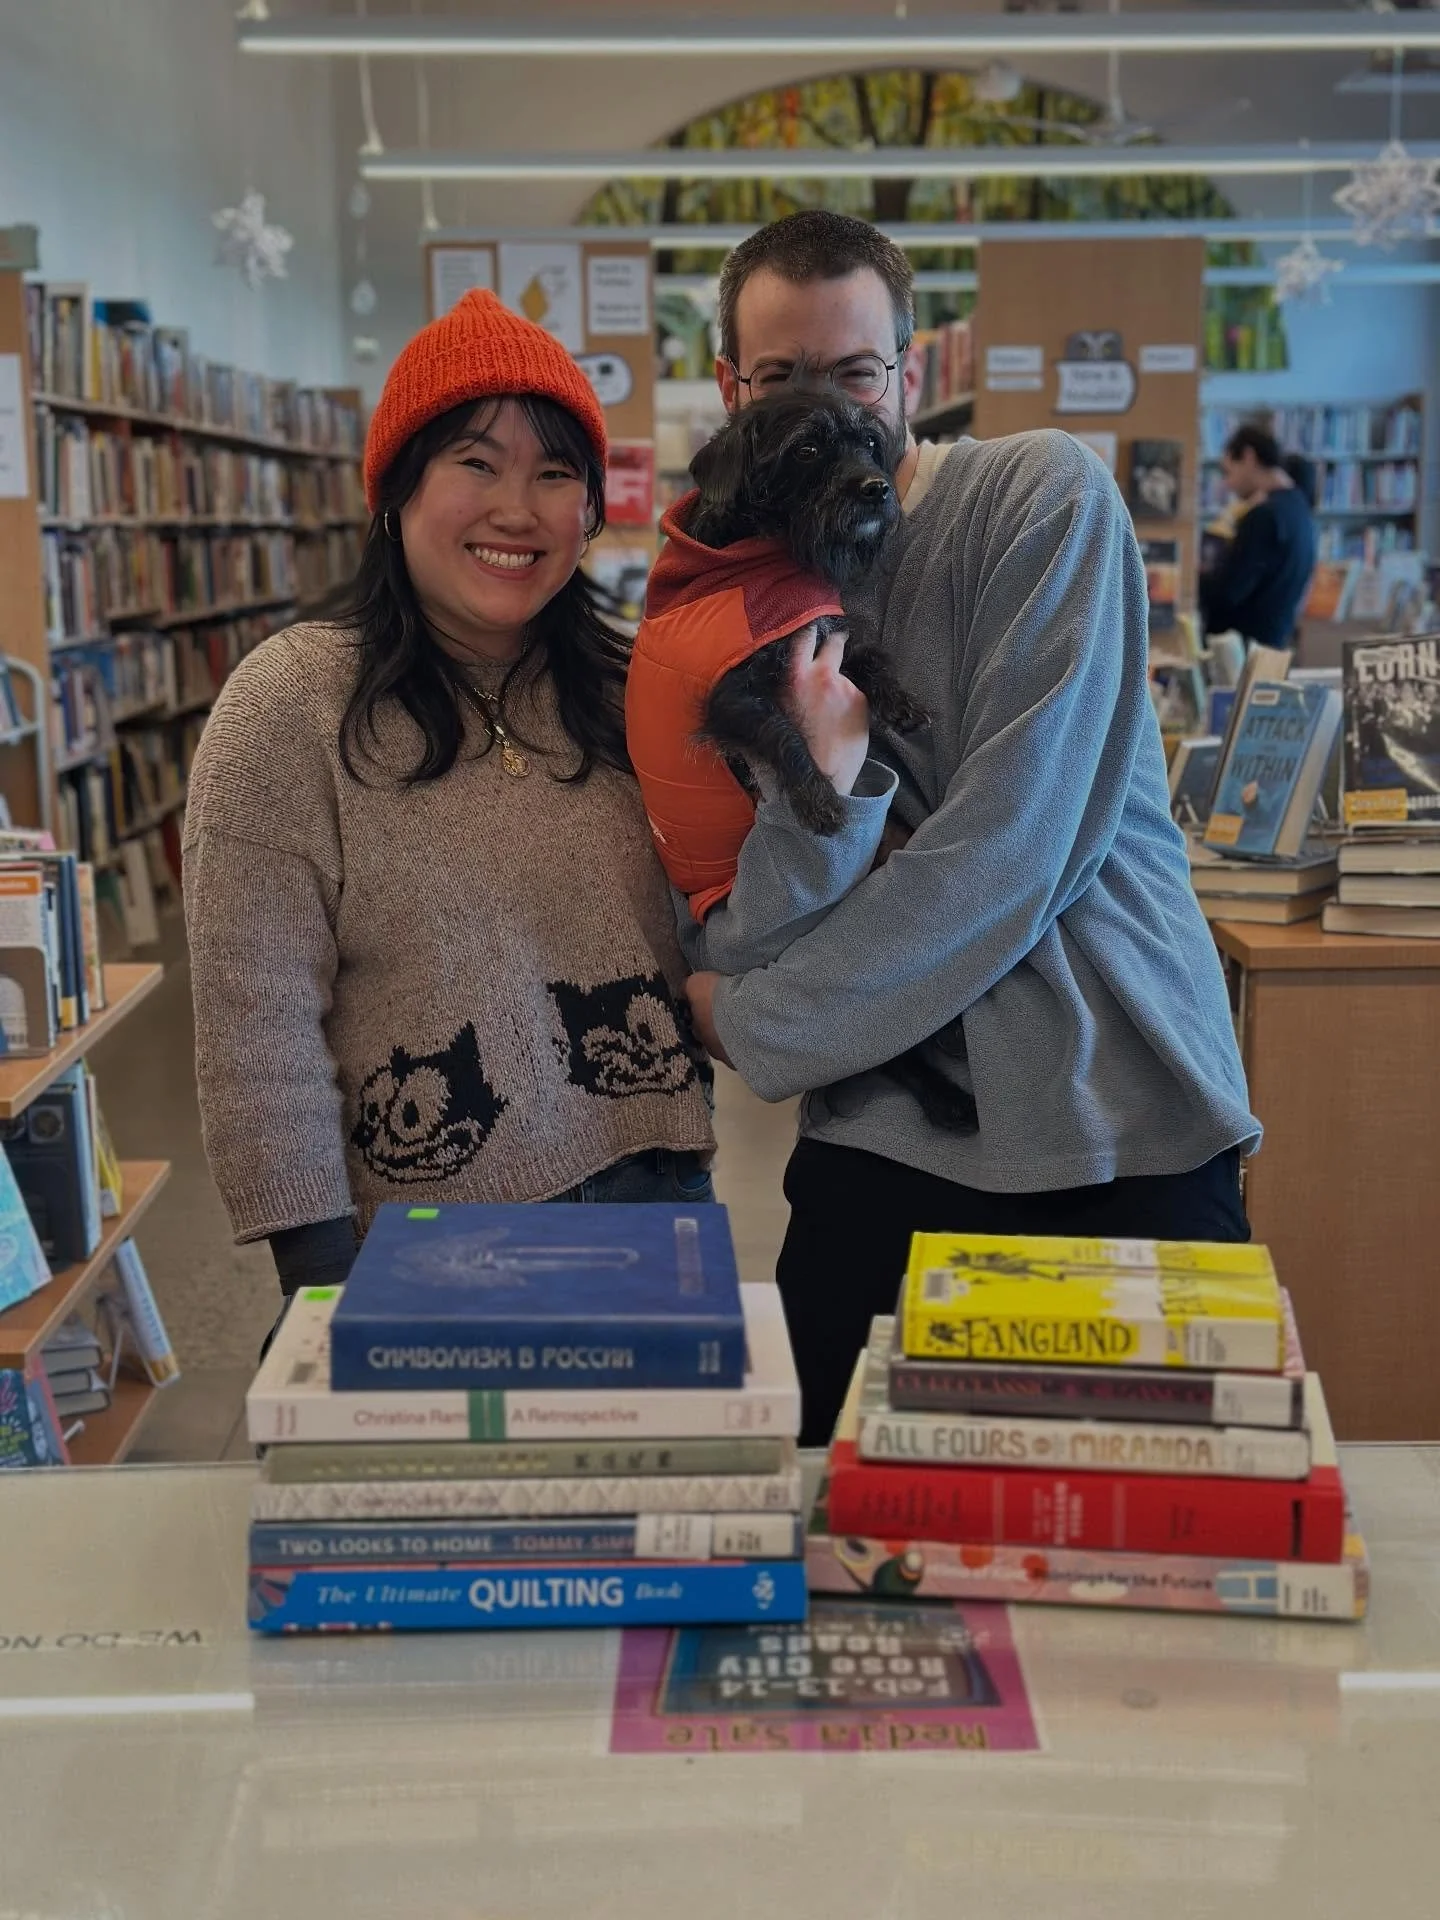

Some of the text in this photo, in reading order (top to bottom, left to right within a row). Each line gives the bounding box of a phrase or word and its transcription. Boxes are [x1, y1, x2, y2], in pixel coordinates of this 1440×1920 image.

[1243, 716, 1305, 741] ATTACK
[1231, 753, 1298, 781] WITHIN
[962, 1317, 1132, 1357] FANGLAND
[368, 1346, 511, 1370] СИМВОЛИЗМ
[542, 1346, 634, 1369] РОССИИ
[512, 1407, 639, 1428] A Retrospective
[874, 1425, 922, 1455] ALL
[933, 1427, 1025, 1459] FOURS
[1069, 1432, 1214, 1467] MIRANDA
[279, 1539, 324, 1555] TWO
[329, 1537, 394, 1555] LOOKS
[400, 1537, 428, 1553] TO
[435, 1536, 492, 1553] HOME
[511, 1535, 582, 1552] TOMMY
[1162, 1573, 1213, 1590] Future
[317, 1578, 683, 1610] The Ultimate QUILTING Book
[56, 1632, 121, 1648] DO
[138, 1629, 201, 1648] WE
[759, 1634, 903, 1655] Reads
[718, 1655, 945, 1676] Rose City
[667, 1719, 987, 1751] Media Sale
